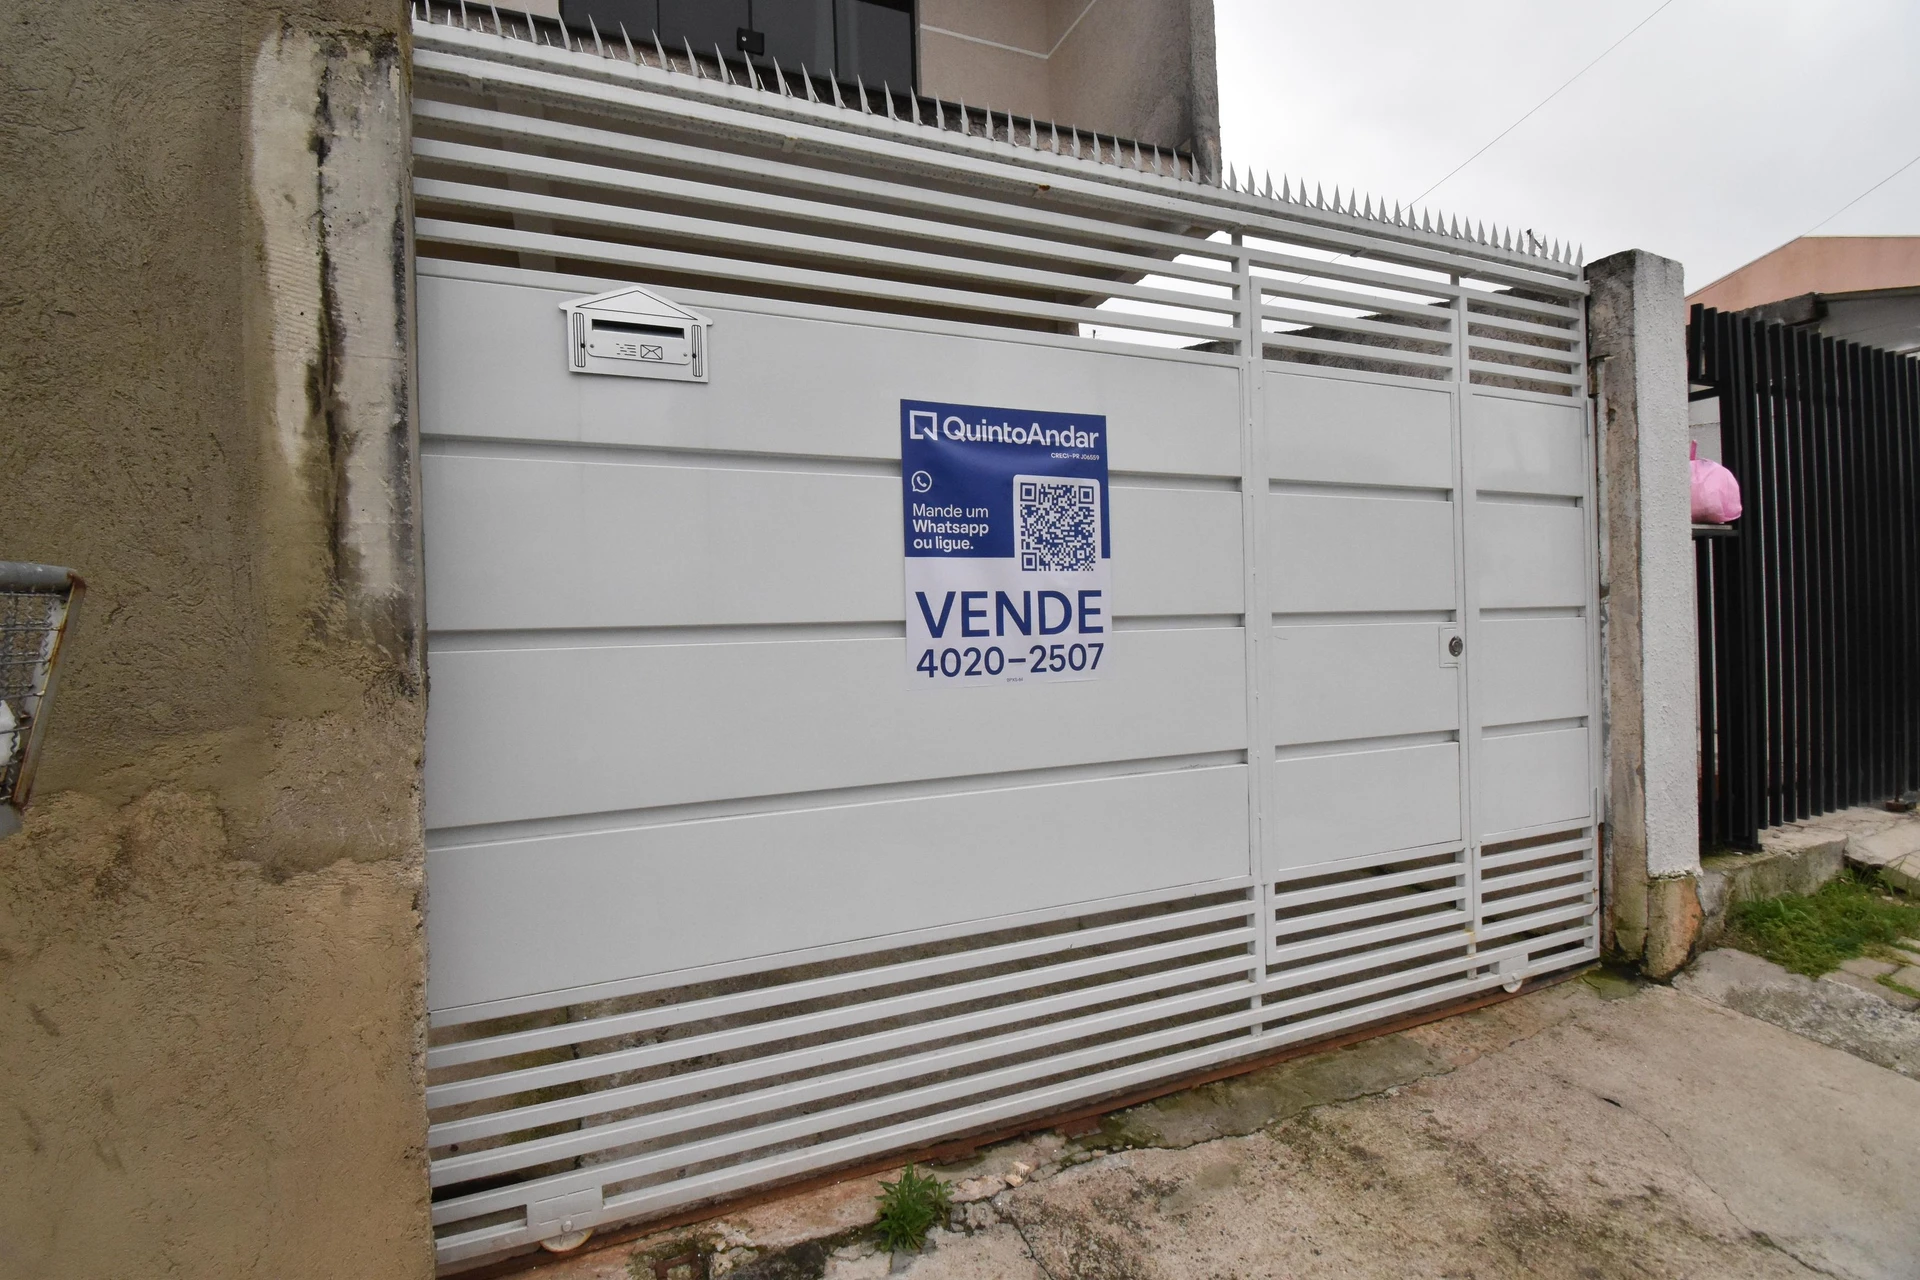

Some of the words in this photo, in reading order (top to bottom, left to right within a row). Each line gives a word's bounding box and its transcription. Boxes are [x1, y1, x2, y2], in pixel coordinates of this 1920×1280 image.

[943, 416, 1099, 448] QuintoAndar
[912, 503, 963, 518] Mande
[965, 507, 989, 518] um
[912, 520, 989, 537] Whatsapp
[913, 539, 933, 550] ou
[935, 535, 974, 553] ligue.
[915, 590, 1104, 639] VENDE
[916, 643, 1104, 678] 4020-2507
